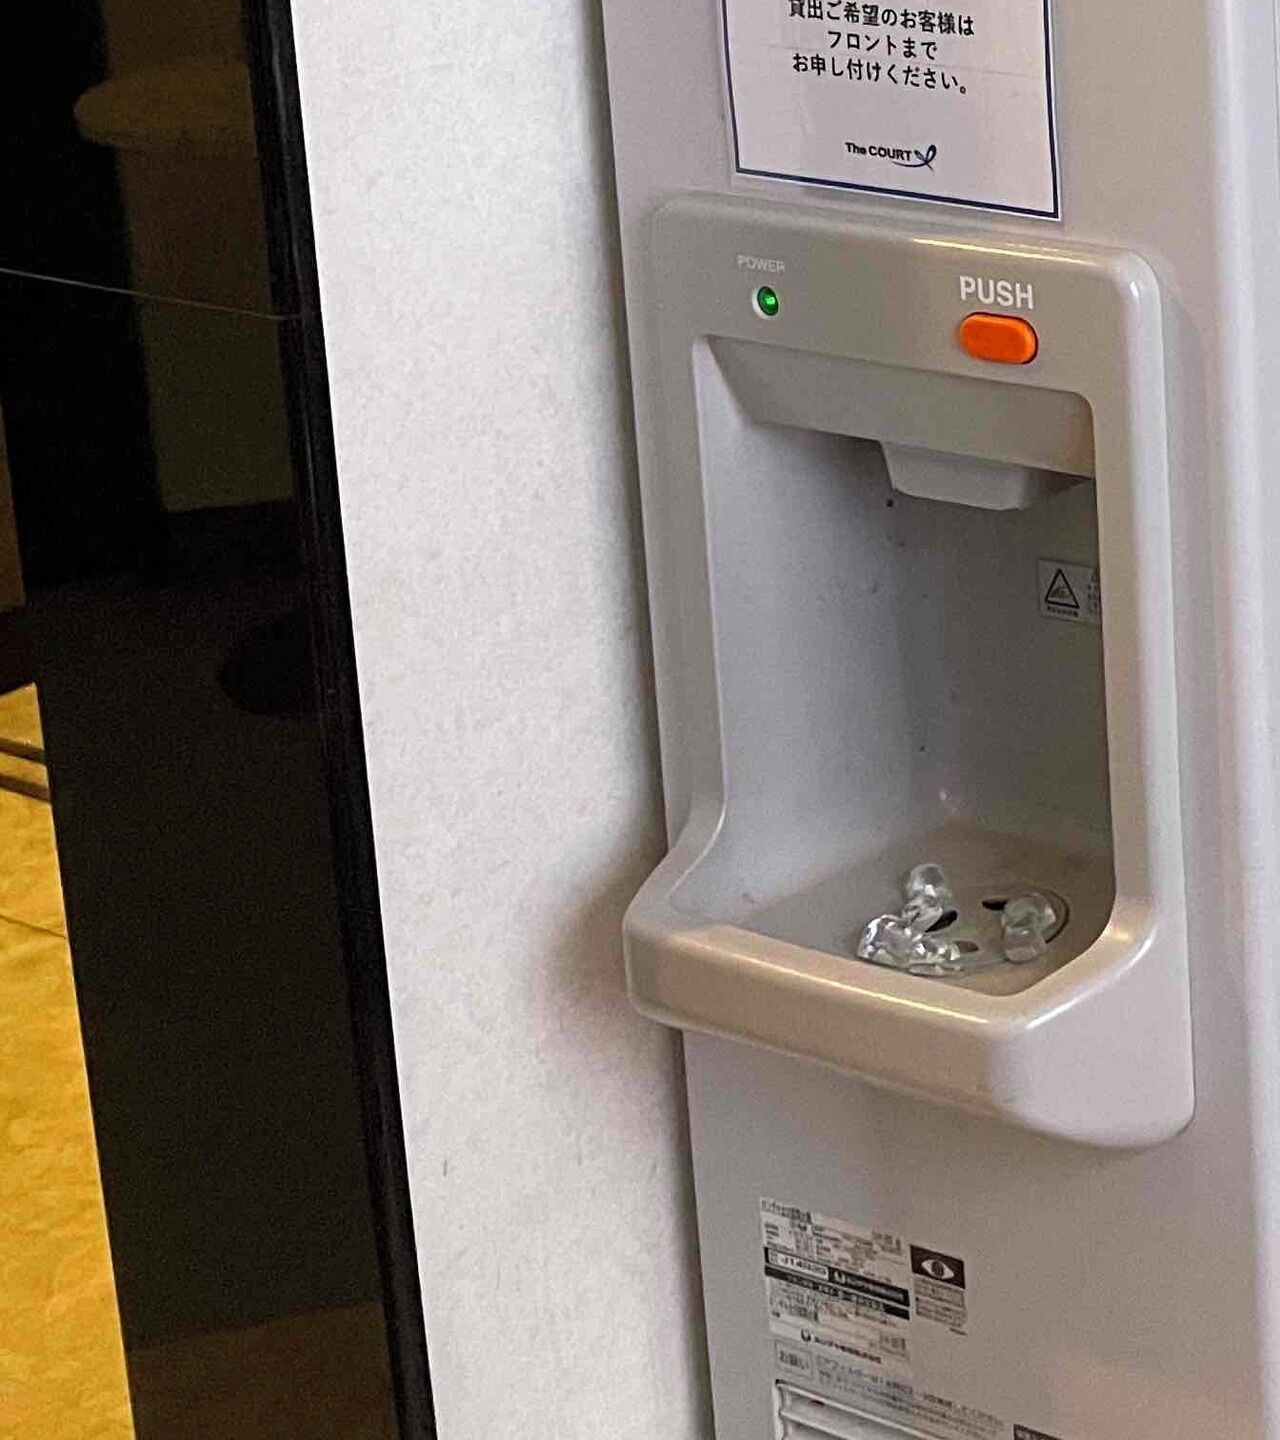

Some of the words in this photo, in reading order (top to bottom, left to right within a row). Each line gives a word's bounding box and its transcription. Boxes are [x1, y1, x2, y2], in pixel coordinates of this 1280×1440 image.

[827, 30, 937, 61] フロントまで
[792, 53, 968, 94] お申し付けください。
[845, 142, 867, 157] The
[868, 145, 911, 162] COURT
[737, 255, 786, 273] POWER
[959, 275, 1034, 310] PUSH
